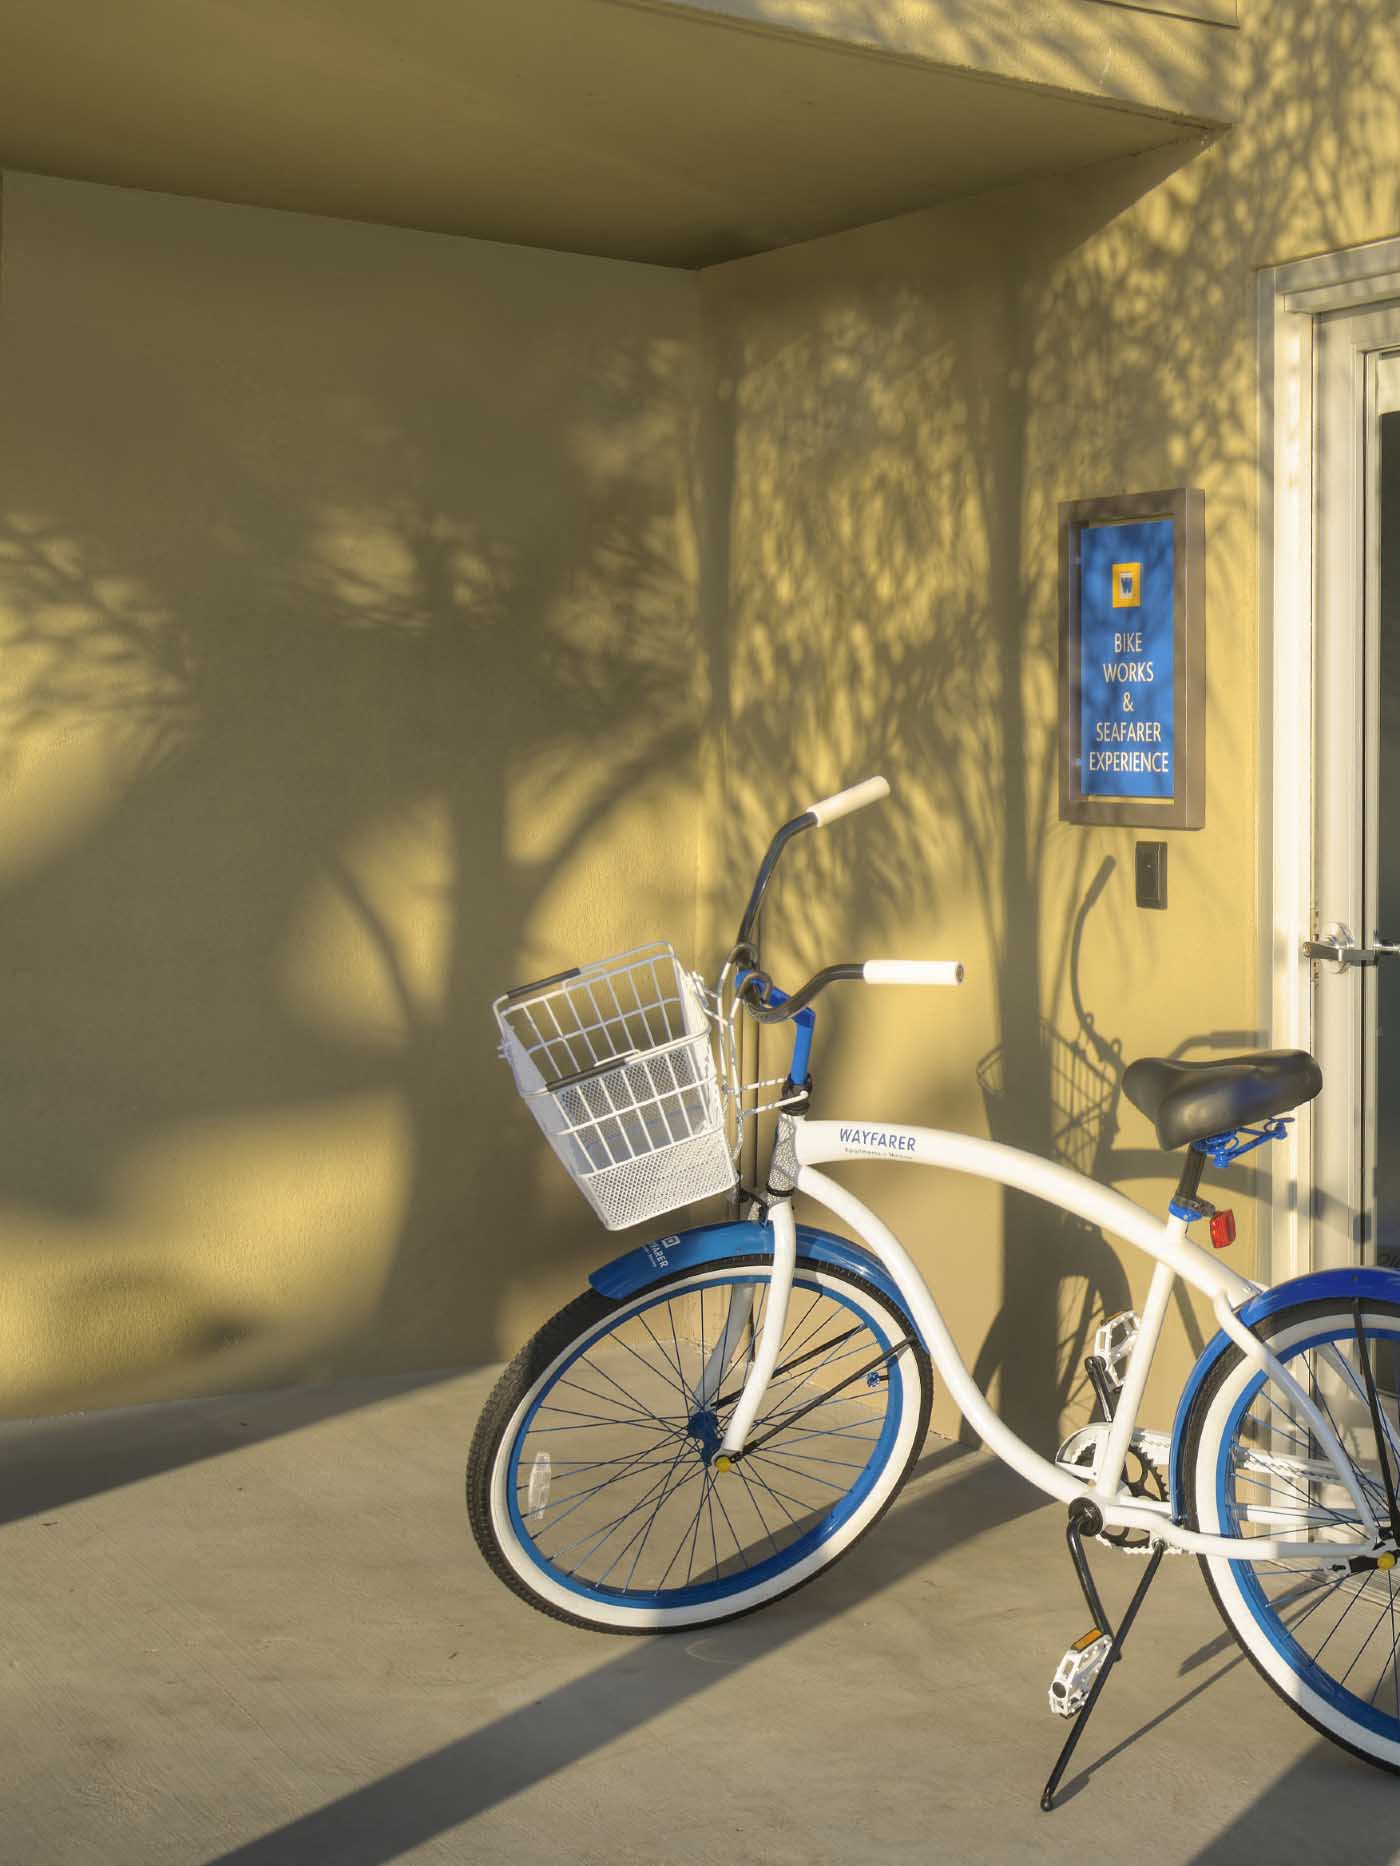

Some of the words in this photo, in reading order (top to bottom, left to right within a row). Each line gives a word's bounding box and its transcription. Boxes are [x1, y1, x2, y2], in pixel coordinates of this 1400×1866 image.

[1114, 632, 1143, 653] BIKE
[1103, 662, 1155, 683] WORKS
[1122, 692, 1134, 712] &
[1096, 722, 1162, 742] SEAFARER
[1089, 752, 1169, 773] EXPERIENCE
[840, 1127, 916, 1152] WAYFARER
